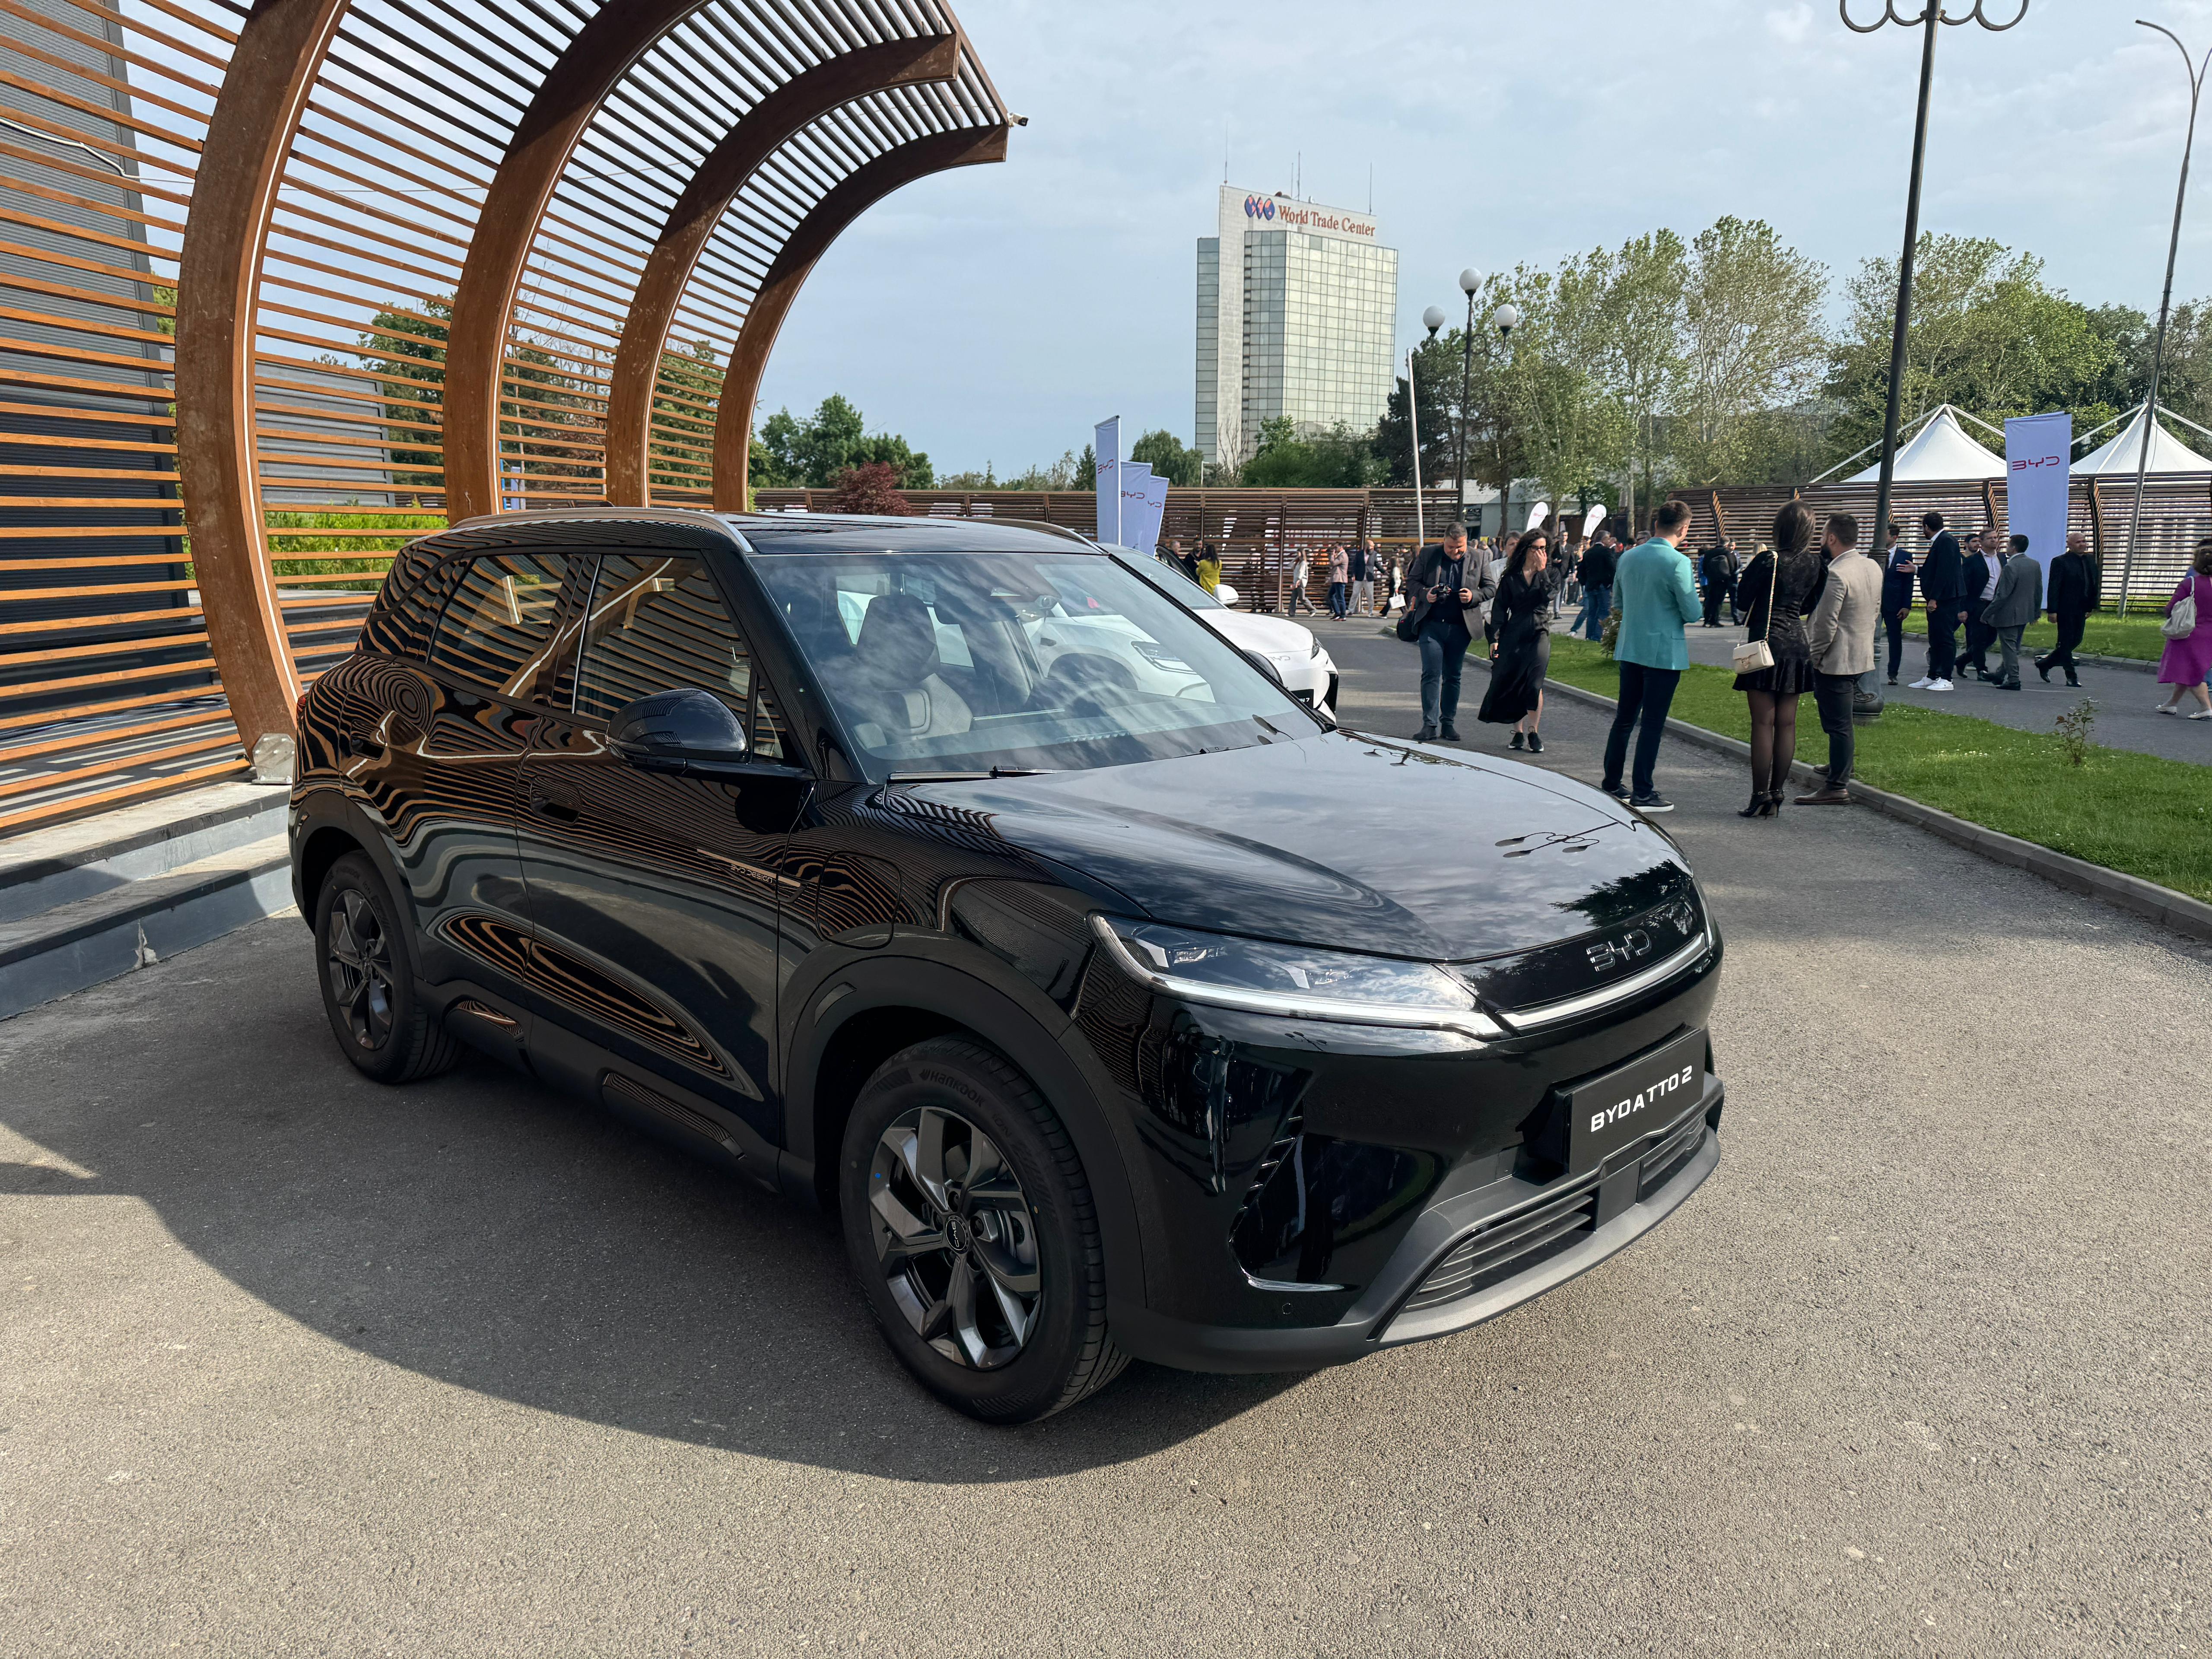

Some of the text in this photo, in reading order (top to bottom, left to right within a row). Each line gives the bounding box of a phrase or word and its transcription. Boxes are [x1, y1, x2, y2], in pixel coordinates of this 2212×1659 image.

[1278, 205, 1375, 237] World Trade Center
[1097, 459, 1114, 474] BYD
[2012, 456, 2060, 470] BYD
[746, 869, 772, 884] DESIGN
[1586, 929, 1652, 972] BYD
[1682, 1065, 1692, 1084] 2
[951, 1221, 960, 1248] BYD
